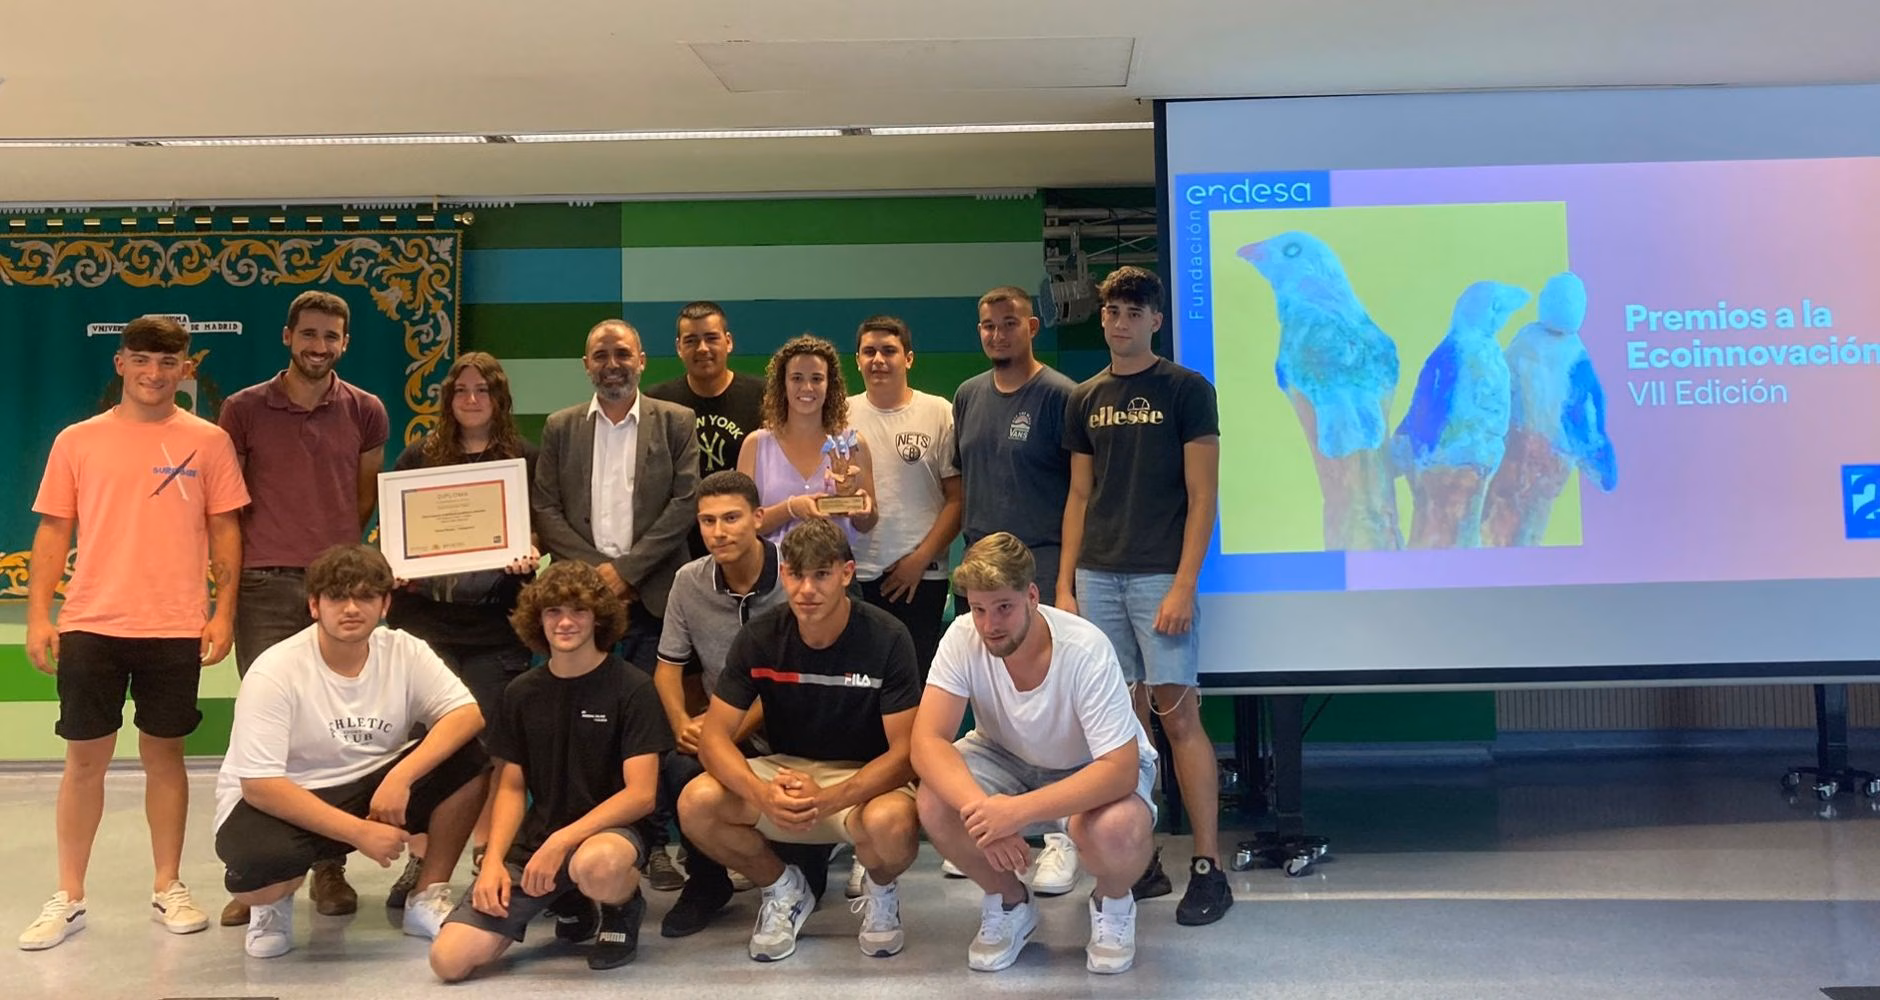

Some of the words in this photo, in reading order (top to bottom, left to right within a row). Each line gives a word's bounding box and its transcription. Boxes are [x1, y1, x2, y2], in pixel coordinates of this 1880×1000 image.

[1186, 178, 1312, 205] endesa
[1186, 210, 1205, 320] Fundación
[204, 322, 239, 331] MADRID
[1625, 301, 1768, 332] Premios
[1775, 307, 1796, 329] a
[1802, 298, 1833, 329] la
[1626, 335, 1880, 370] Ecoinnovación
[1627, 380, 1667, 406] VII
[1675, 377, 1788, 406] Edición
[708, 414, 744, 440] YORK
[1089, 405, 1164, 429] ellesse
[897, 434, 929, 449] NETS
[844, 672, 871, 687] FILA
[599, 931, 626, 943] PUMA
